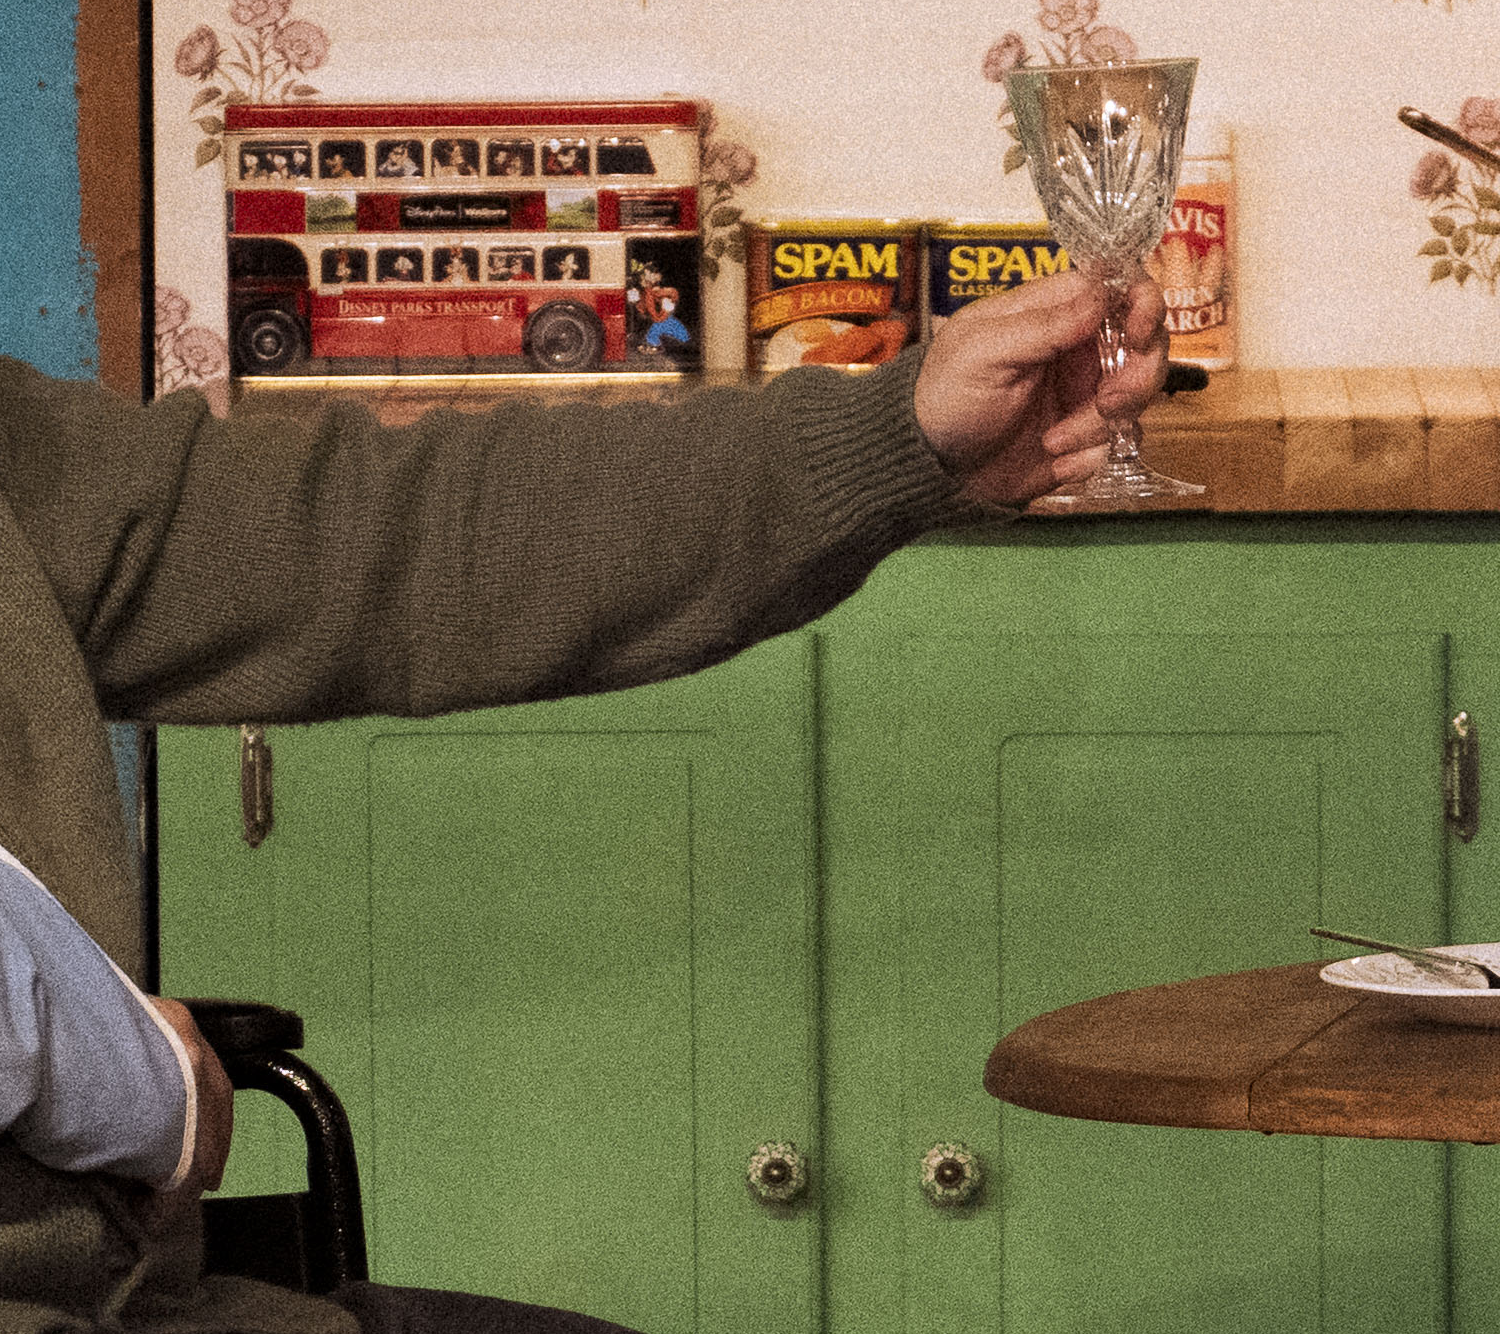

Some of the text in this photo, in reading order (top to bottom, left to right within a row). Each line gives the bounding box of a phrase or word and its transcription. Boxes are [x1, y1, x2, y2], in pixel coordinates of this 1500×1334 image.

[1163, 205, 1221, 239] AVIS
[773, 242, 899, 278] SPAM
[948, 245, 1071, 281] SPAM
[339, 298, 516, 315] DISNEY PARKS TRANSPORT
[799, 287, 883, 311] BACON
[1161, 286, 1213, 309] ORN
[1163, 302, 1223, 331] ARCH
